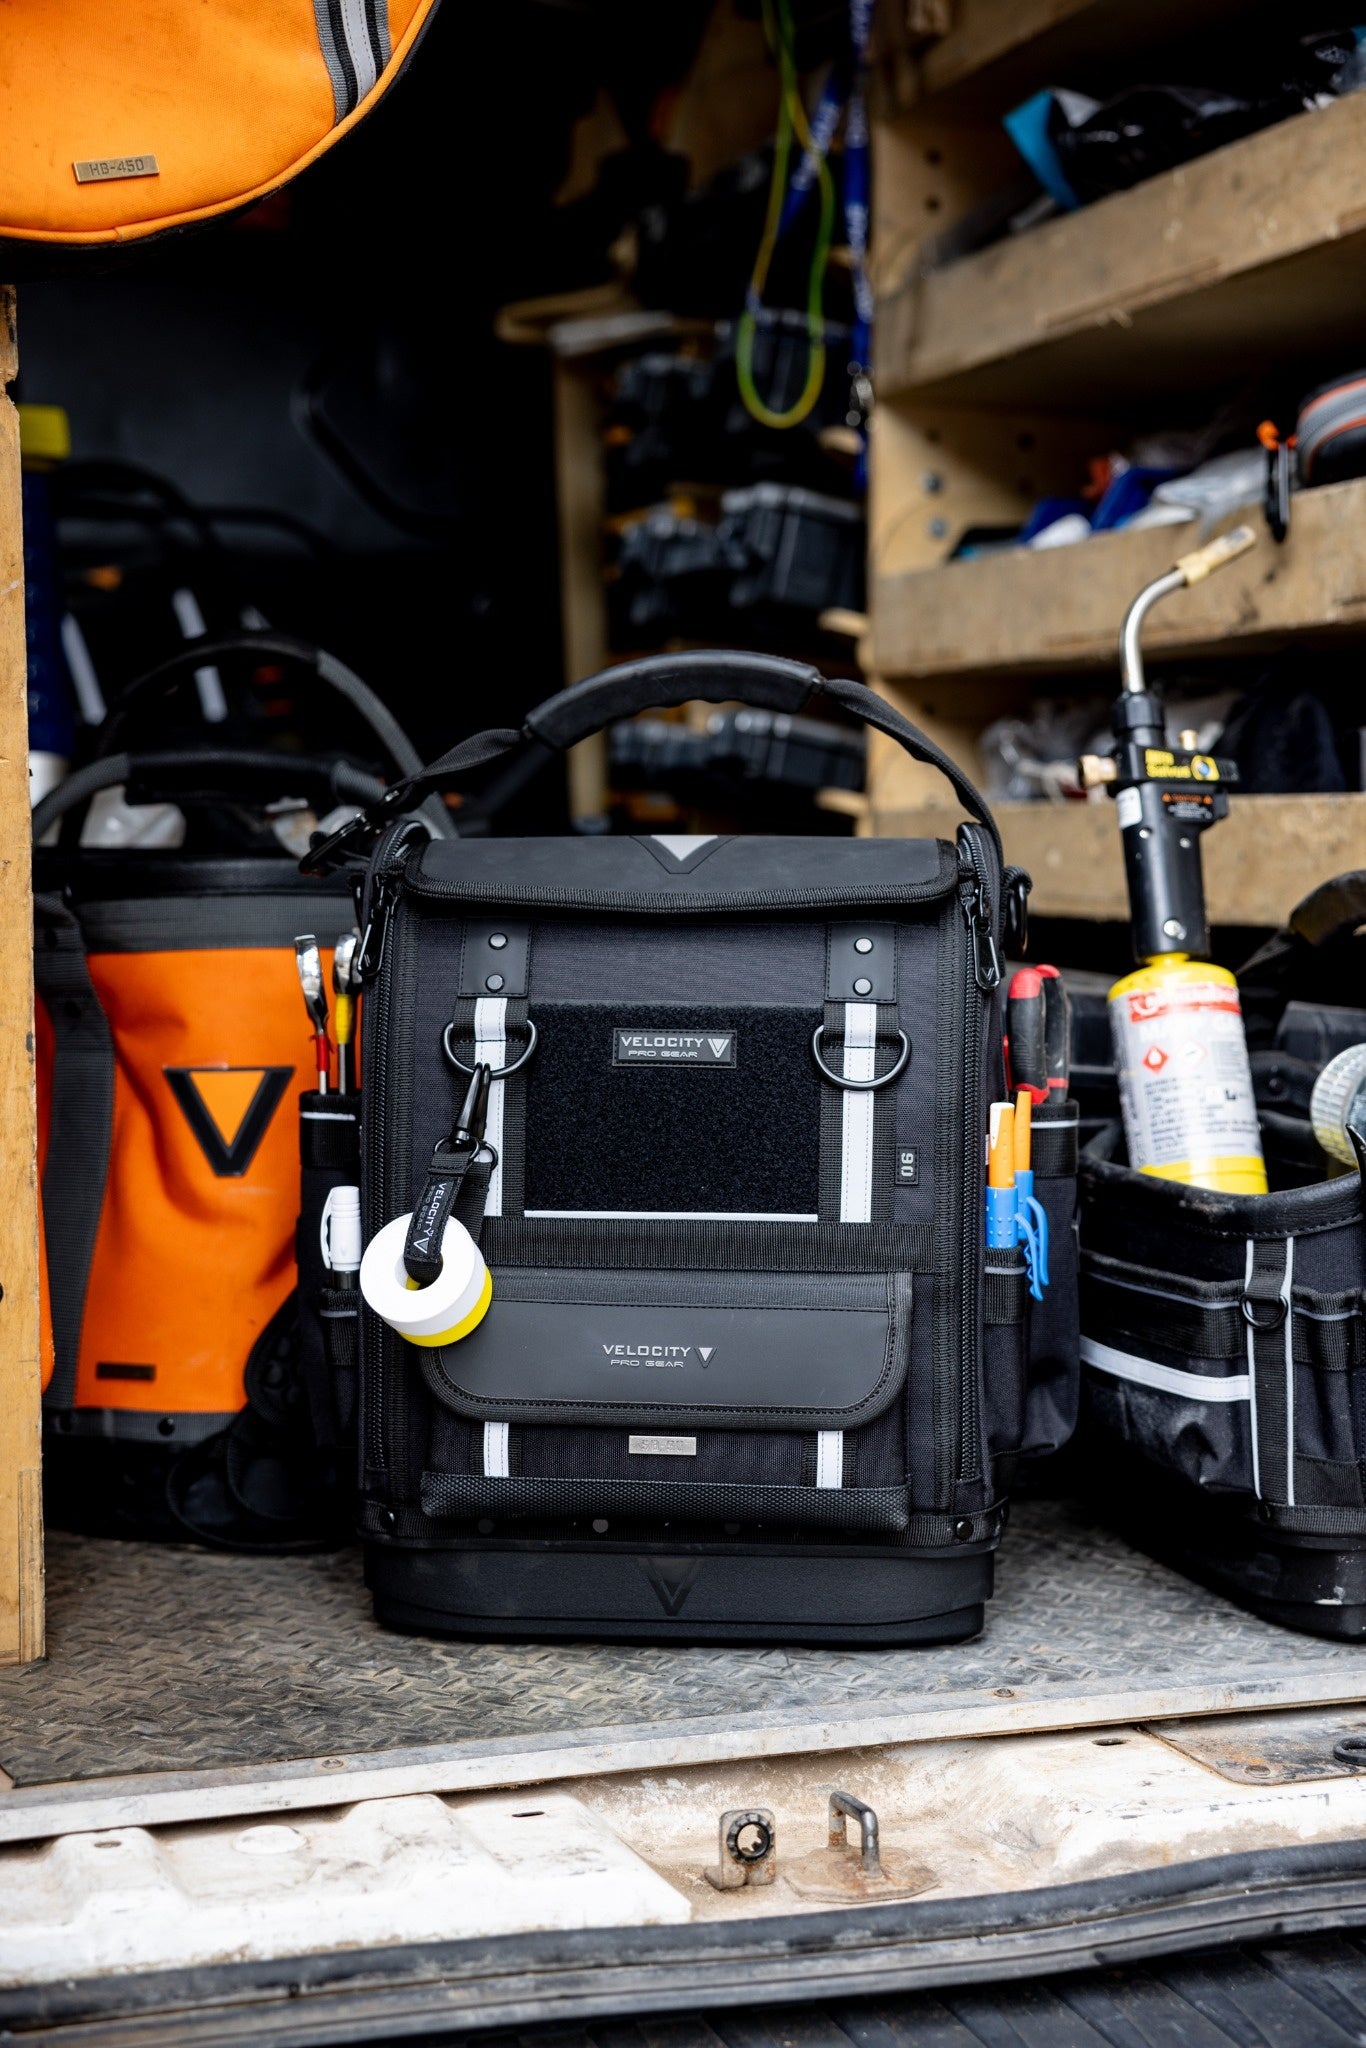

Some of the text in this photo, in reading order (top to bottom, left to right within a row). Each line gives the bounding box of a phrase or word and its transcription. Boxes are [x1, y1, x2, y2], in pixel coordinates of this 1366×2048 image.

[88, 158, 145, 176] HB-450
[620, 1036, 704, 1048] VELOCITY
[660, 1050, 698, 1058] GEAR
[423, 1182, 447, 1237] VELOCITY
[602, 1344, 691, 1357] VELOCITY
[610, 1359, 684, 1368] PRO GEAR
